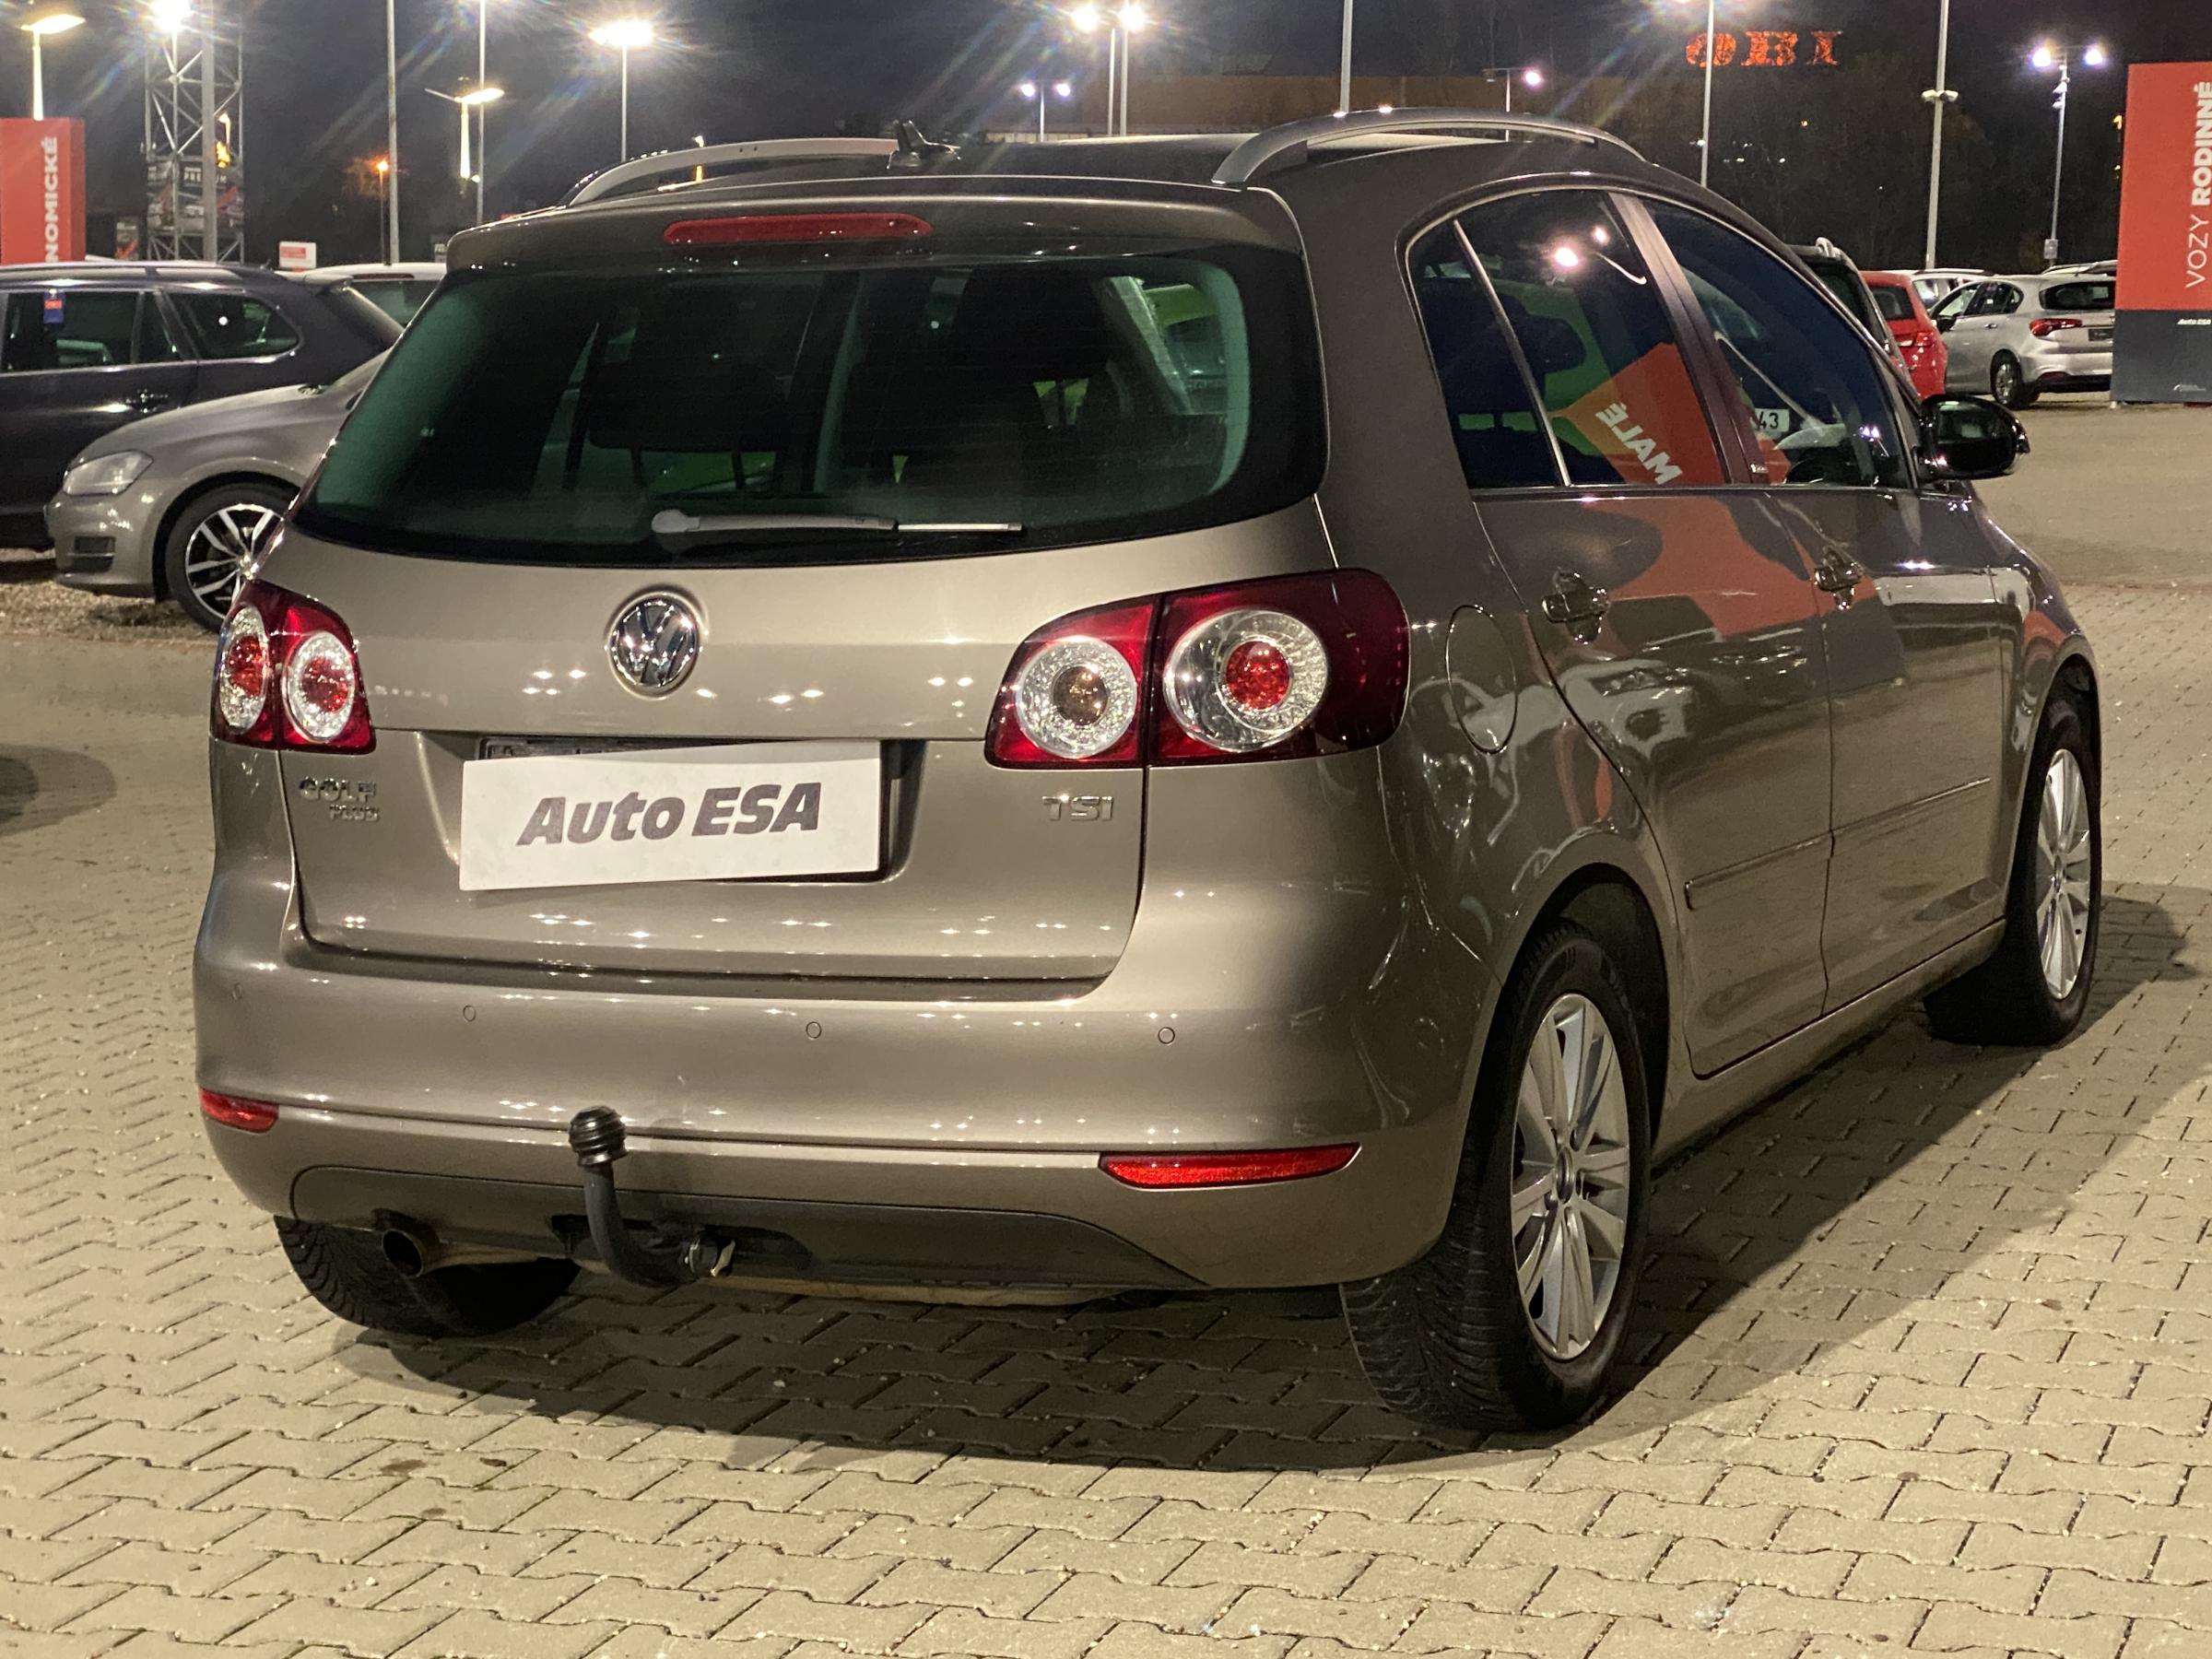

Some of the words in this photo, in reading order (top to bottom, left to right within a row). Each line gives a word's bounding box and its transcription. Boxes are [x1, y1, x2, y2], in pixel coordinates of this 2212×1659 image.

[1686, 30, 1842, 67] OBI
[2190, 81, 2212, 206] RODINNÉ
[2185, 214, 2209, 288] VOZY
[300, 776, 376, 802] GOLF
[1041, 794, 1113, 821] TSI
[329, 804, 381, 823] PLUS
[515, 792, 685, 847] Auto
[691, 782, 822, 837] ESA
